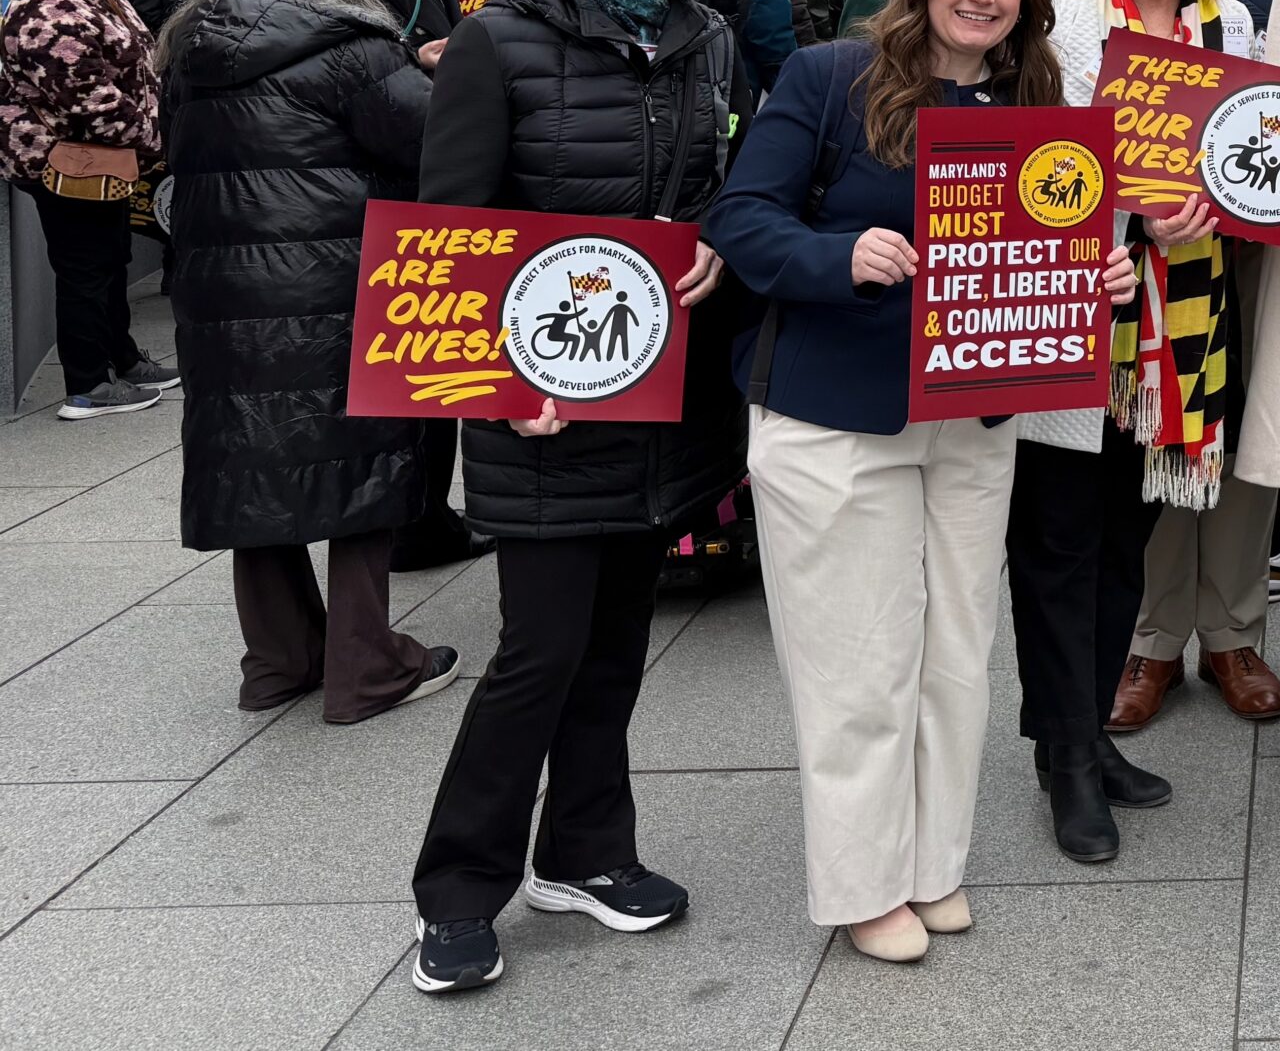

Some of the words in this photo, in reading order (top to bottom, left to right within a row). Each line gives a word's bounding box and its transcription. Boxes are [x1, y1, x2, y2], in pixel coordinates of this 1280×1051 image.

[1127, 54, 1224, 88] THESE
[1101, 77, 1171, 105] ARE
[1114, 106, 1193, 141] OUR
[1213, 103, 1237, 130] PROTECT
[1237, 91, 1270, 107] SERVICES
[929, 162, 1007, 180] MARYLAND'S
[1114, 137, 1207, 176] IVES!
[1206, 141, 1225, 194] INTELLECTUAL
[1222, 192, 1238, 205] AND
[929, 184, 1005, 208] BUDGET
[1034, 209, 1044, 218] AND
[396, 227, 518, 256] THESE
[929, 211, 1005, 238] MUST
[928, 239, 1062, 269] PROTECT
[1069, 237, 1100, 262] OUR
[368, 259, 455, 287] ARE
[514, 266, 540, 302] PROTECT
[539, 246, 577, 270] SERVICES
[579, 245, 596, 254] FOR
[598, 246, 652, 285] MARYLANDERS
[647, 285, 661, 308] WITH
[927, 274, 989, 303] LIFE,
[993, 267, 1102, 299] LIBERTY,
[386, 290, 488, 325] OUR
[924, 310, 942, 337] &
[947, 302, 1098, 336] COMMUNITY
[365, 326, 511, 364] LIVES!
[510, 316, 541, 374] INTELLECTUAL
[538, 371, 557, 385] AND
[558, 369, 633, 391] DEVELOPMENTAL
[632, 322, 661, 370] DISABILITIES
[924, 334, 1096, 372] ACCESS!
